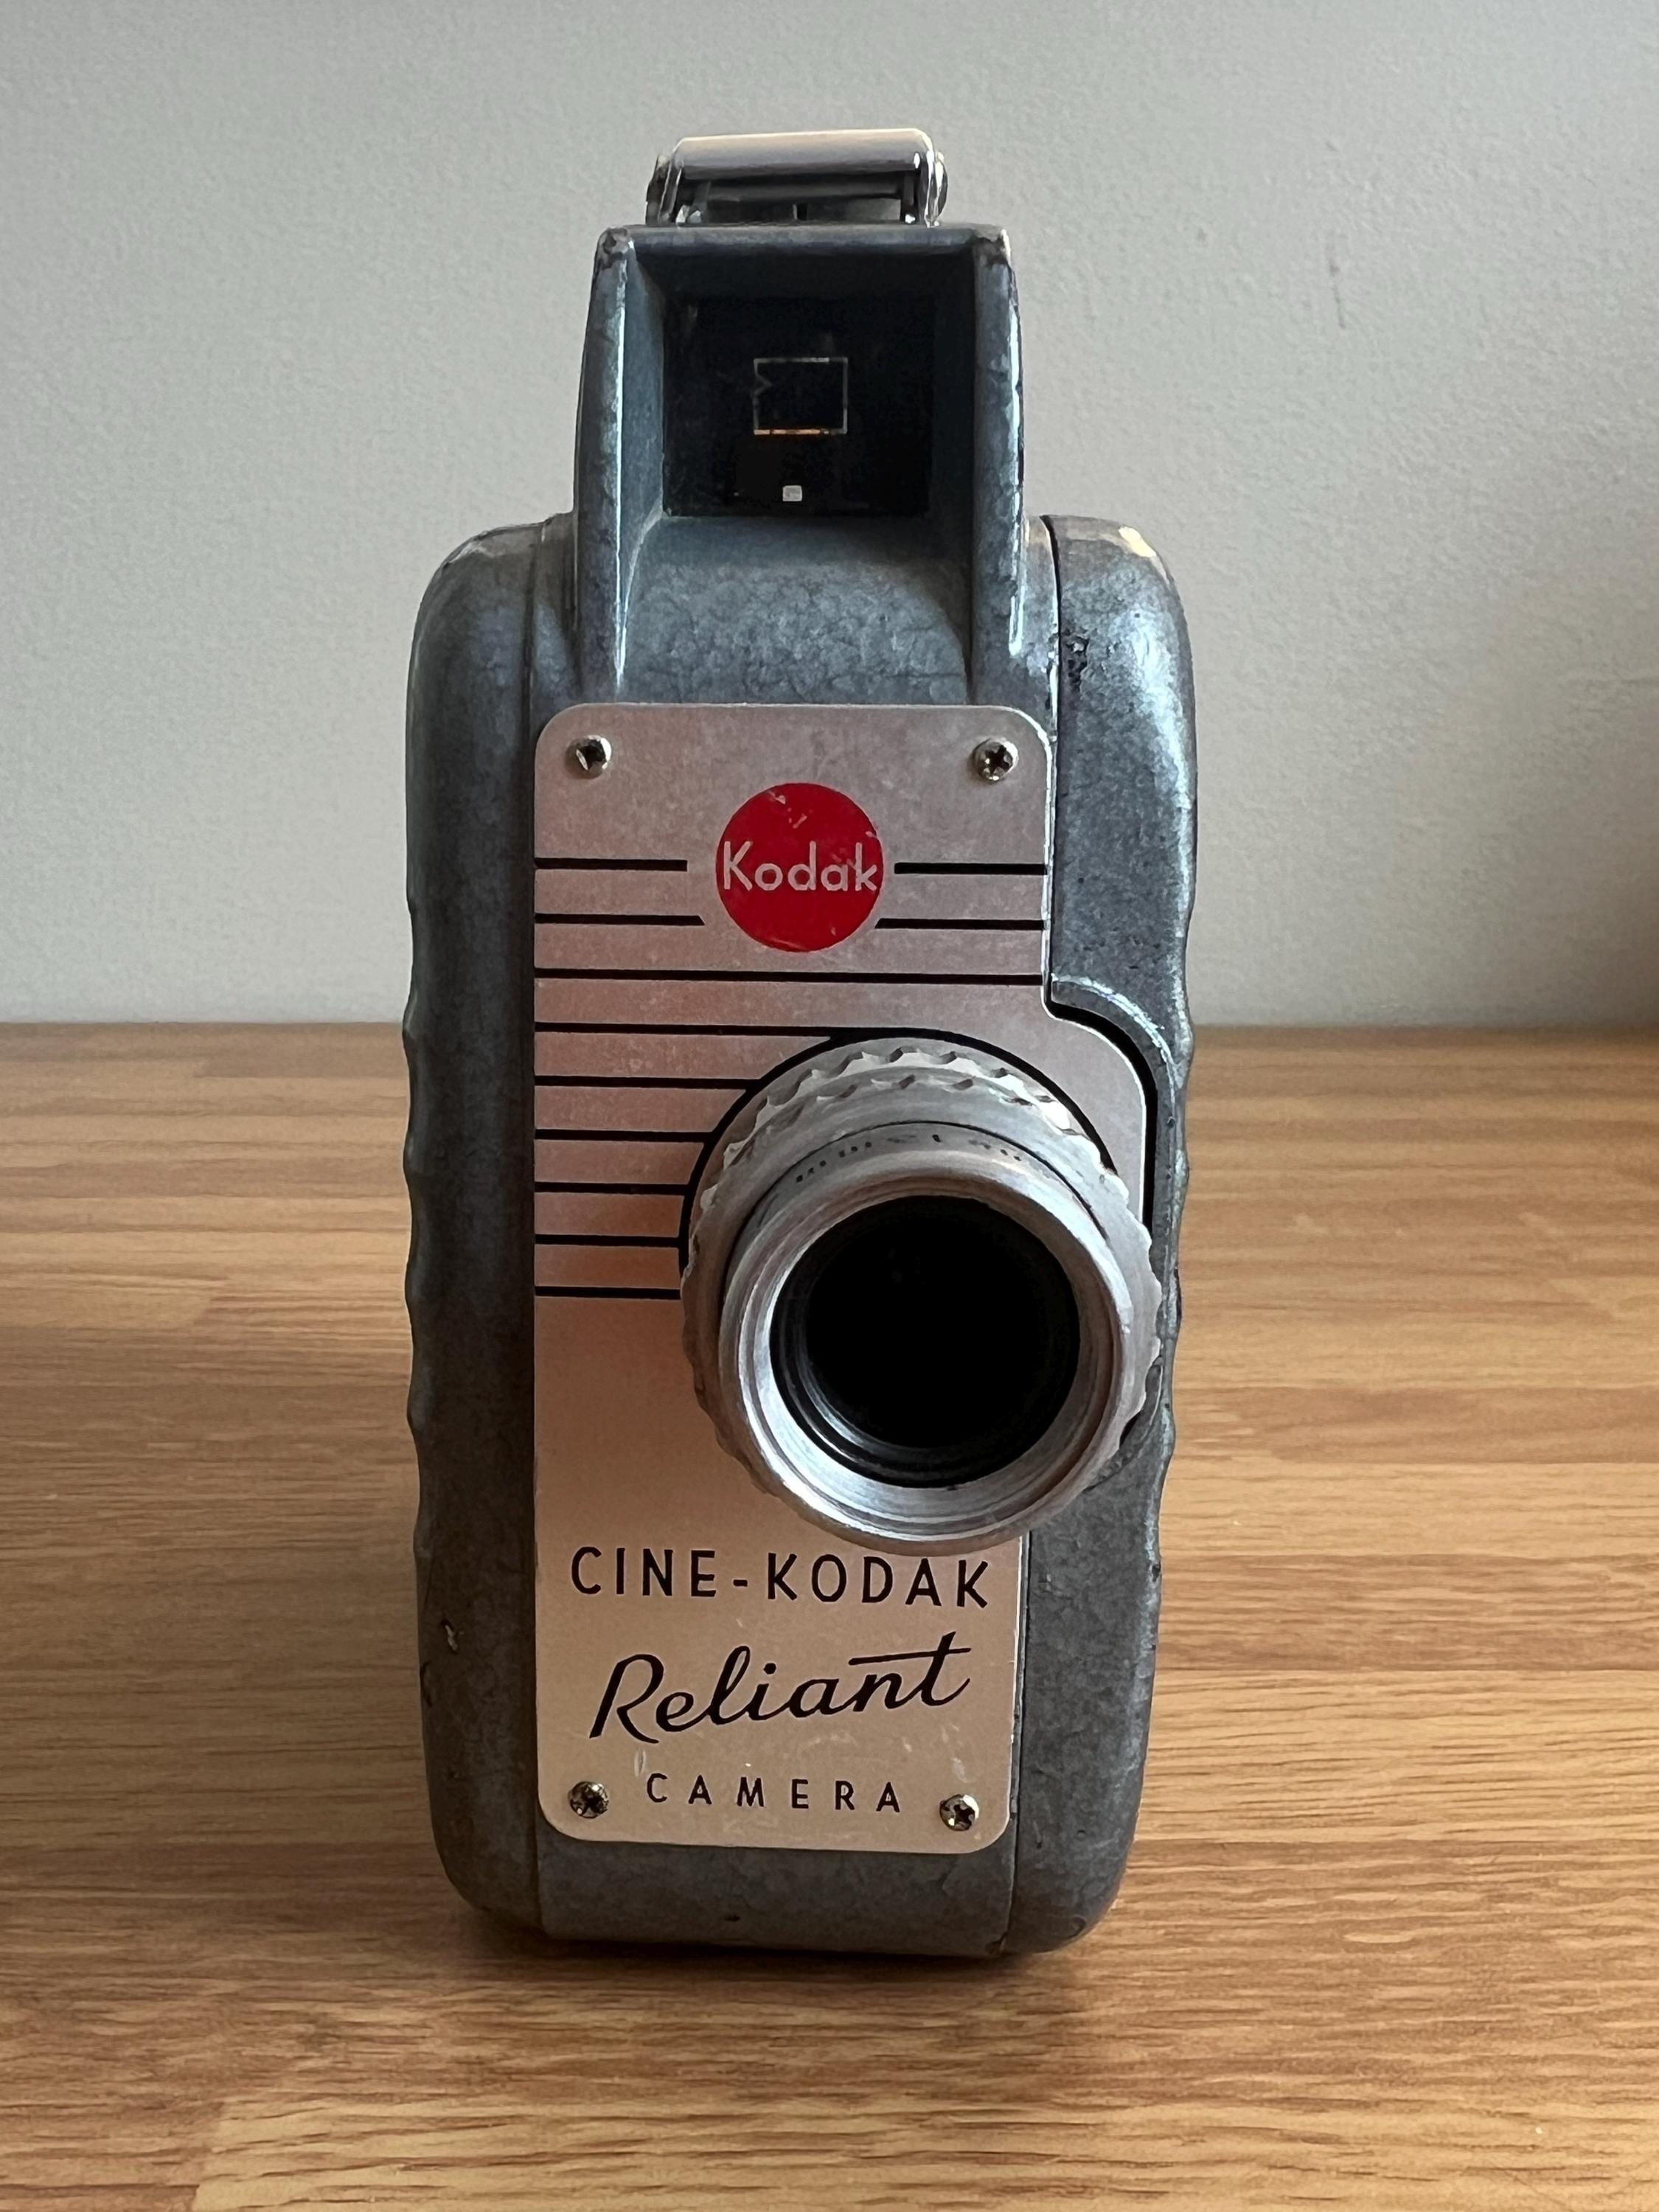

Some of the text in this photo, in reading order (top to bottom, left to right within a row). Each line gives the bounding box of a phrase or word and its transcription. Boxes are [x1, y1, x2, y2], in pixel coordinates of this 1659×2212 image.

[723, 841, 878, 891] Kodak
[571, 1546, 988, 1608] CINE-KODAK
[589, 1631, 972, 1744] Reliant
[646, 1773, 901, 1813] CAMERA
